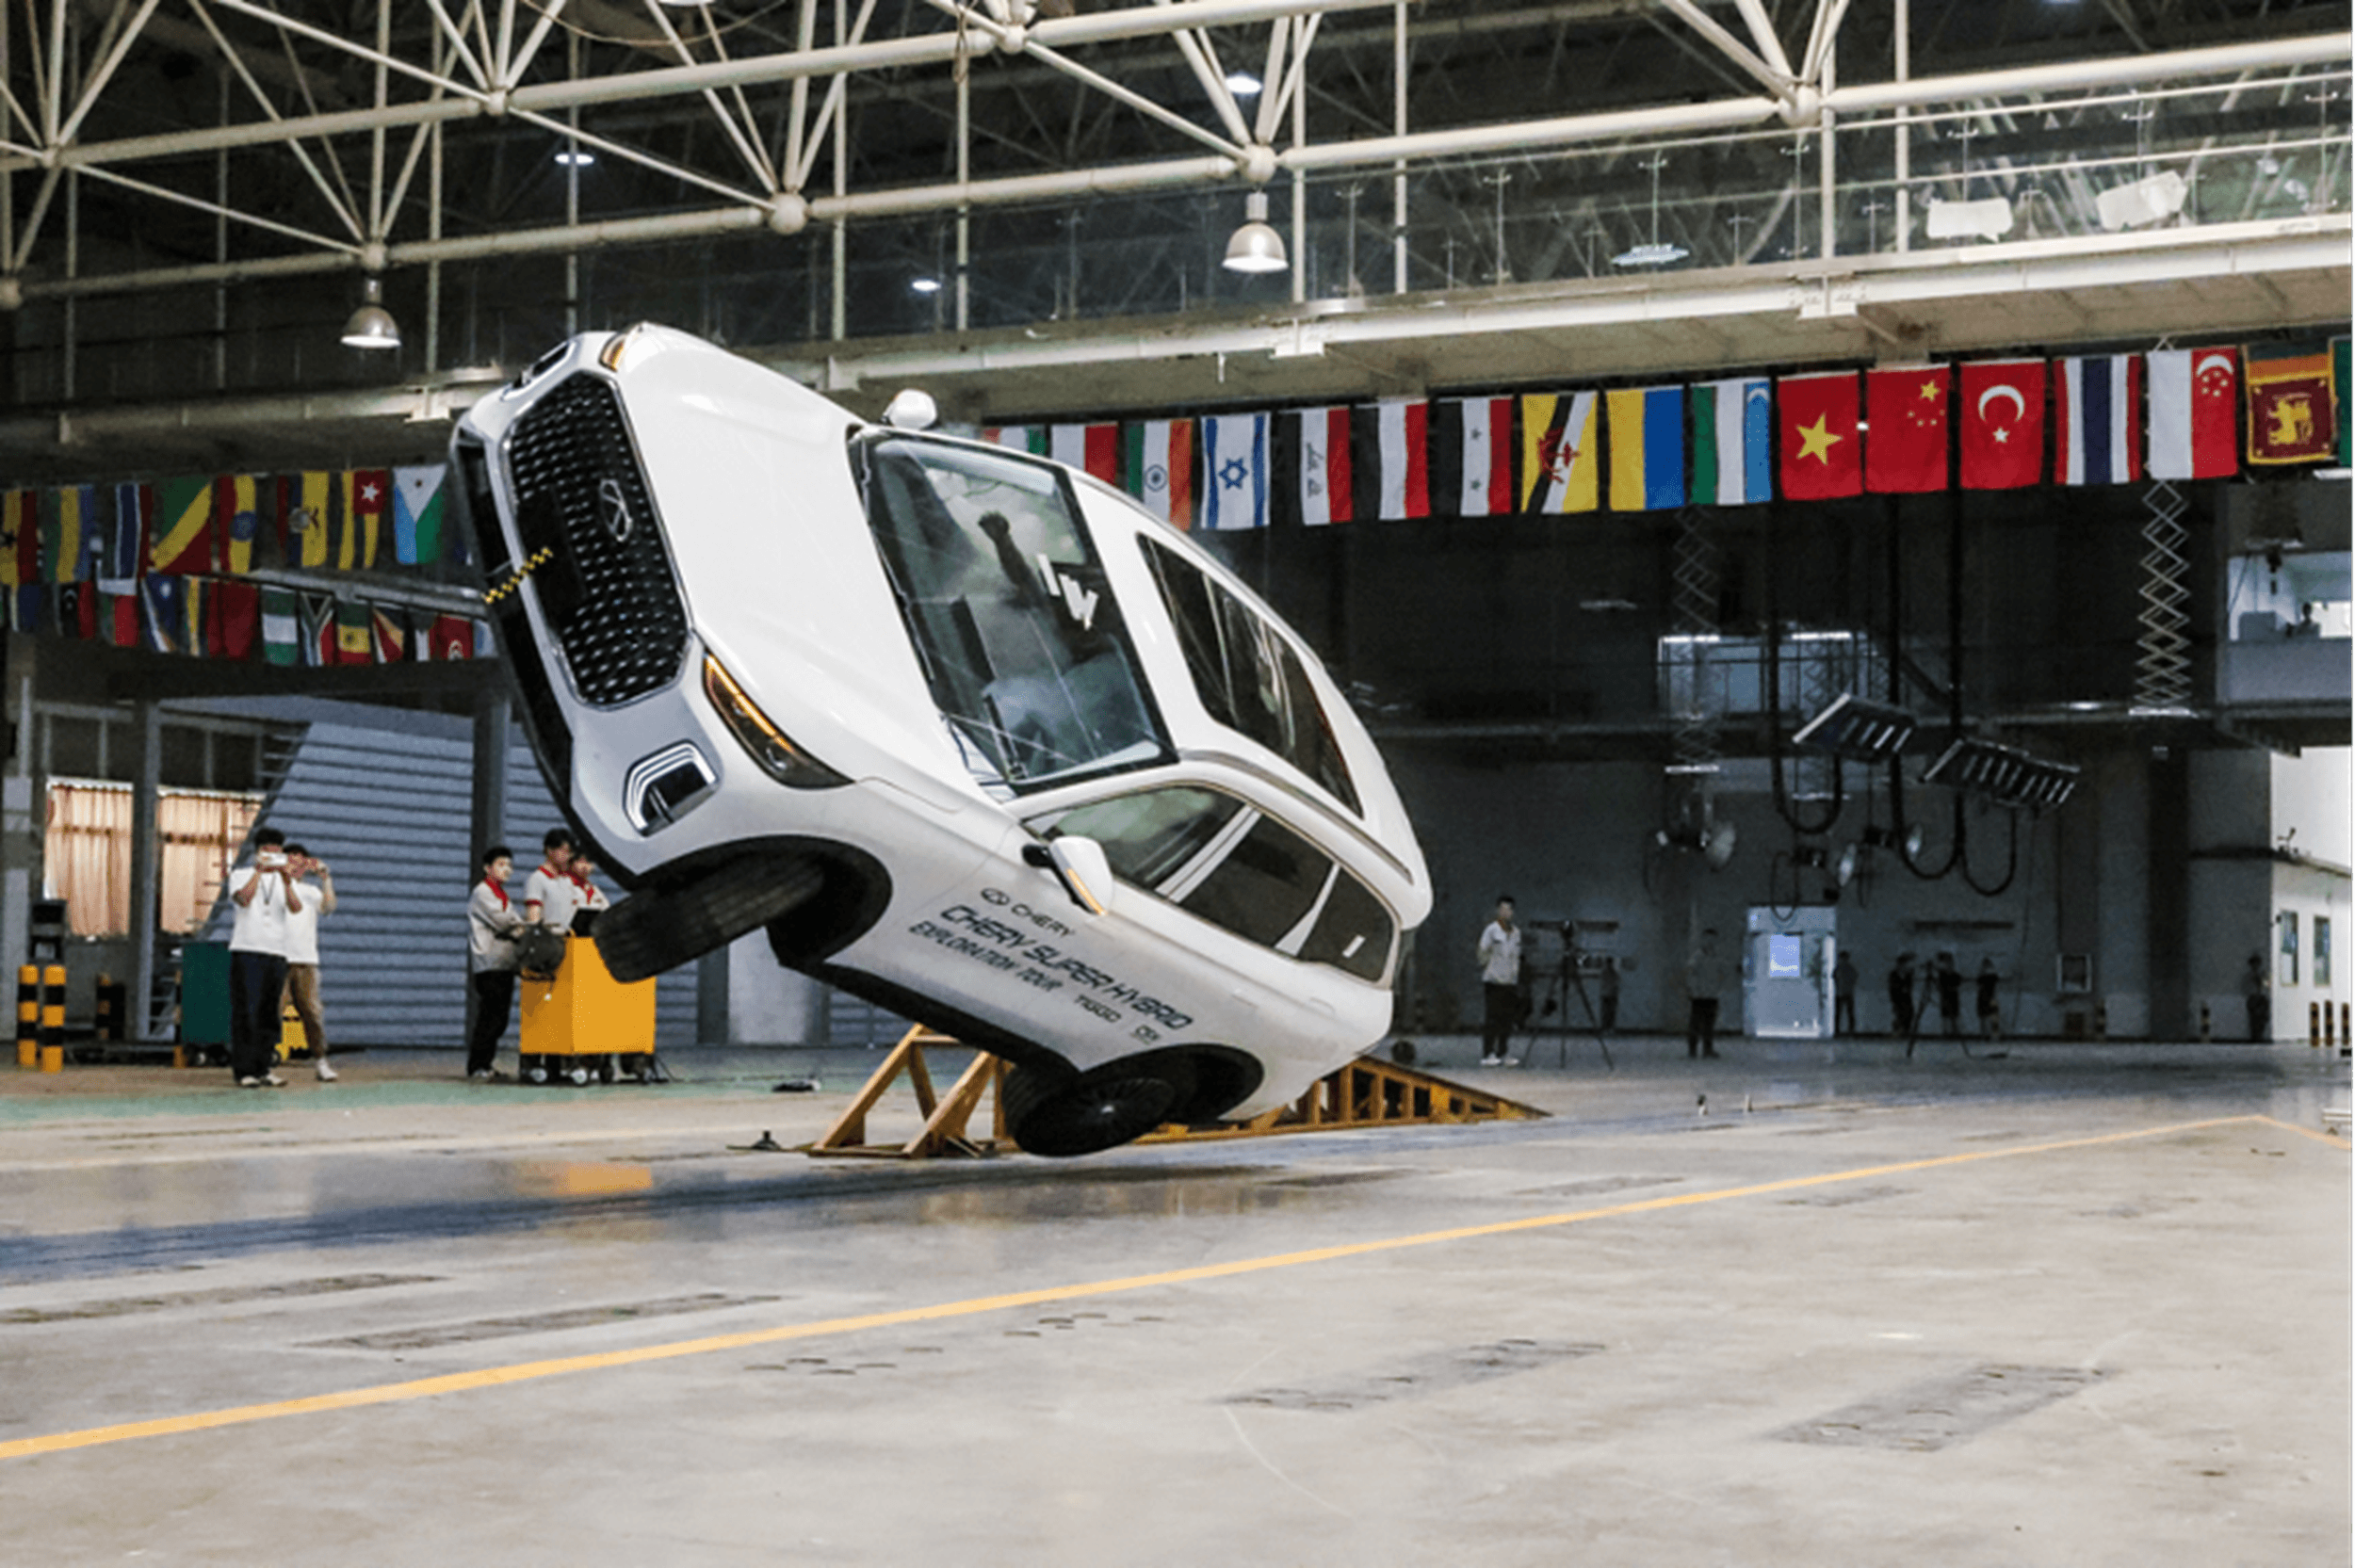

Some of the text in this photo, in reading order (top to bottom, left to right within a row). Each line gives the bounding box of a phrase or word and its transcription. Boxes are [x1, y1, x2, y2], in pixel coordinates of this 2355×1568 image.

[909, 920, 1064, 992] EXPLORATION TOUR
[1011, 902, 1073, 938] CHERY
[941, 905, 1194, 1029] CHERY SUPER HYBRID
